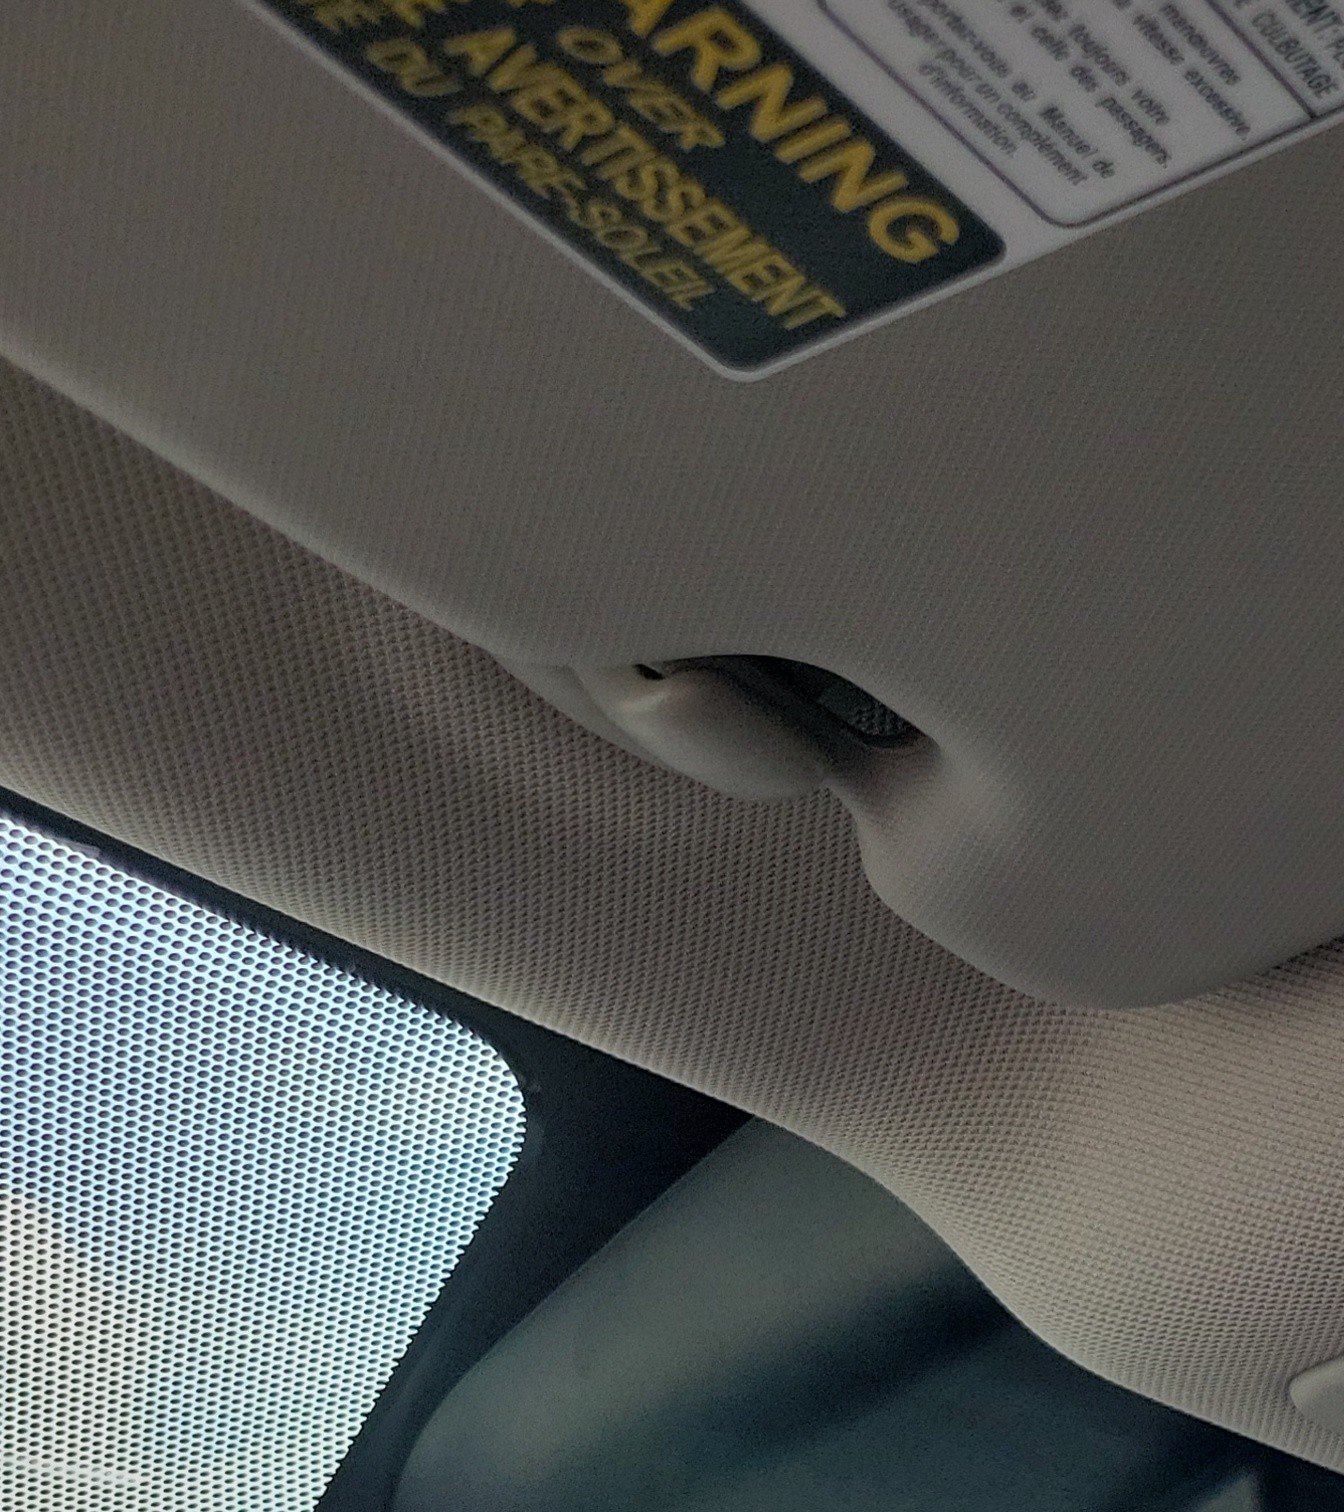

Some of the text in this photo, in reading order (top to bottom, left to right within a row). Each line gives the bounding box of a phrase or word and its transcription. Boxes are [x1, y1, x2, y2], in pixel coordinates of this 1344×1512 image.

[559, 25, 727, 153] OVER
[935, 47, 982, 83] pour
[974, 81, 1003, 105] un
[1068, 22, 1131, 88] toujours
[1131, 88, 1171, 127] votre
[1132, 13, 1186, 66] vitesse
[1252, 8, 1340, 99] CULBUTAGE
[1011, 79, 1037, 103] au
[1037, 102, 1098, 159] Manuel
[1091, 159, 1117, 180] de
[1030, 25, 1071, 62] celle
[1069, 65, 1098, 93] des
[1094, 95, 1173, 170] passagers.
[365, 37, 717, 314] DU PARE-SOLEIL
[443, 27, 846, 330] AVERTISSEMENT
